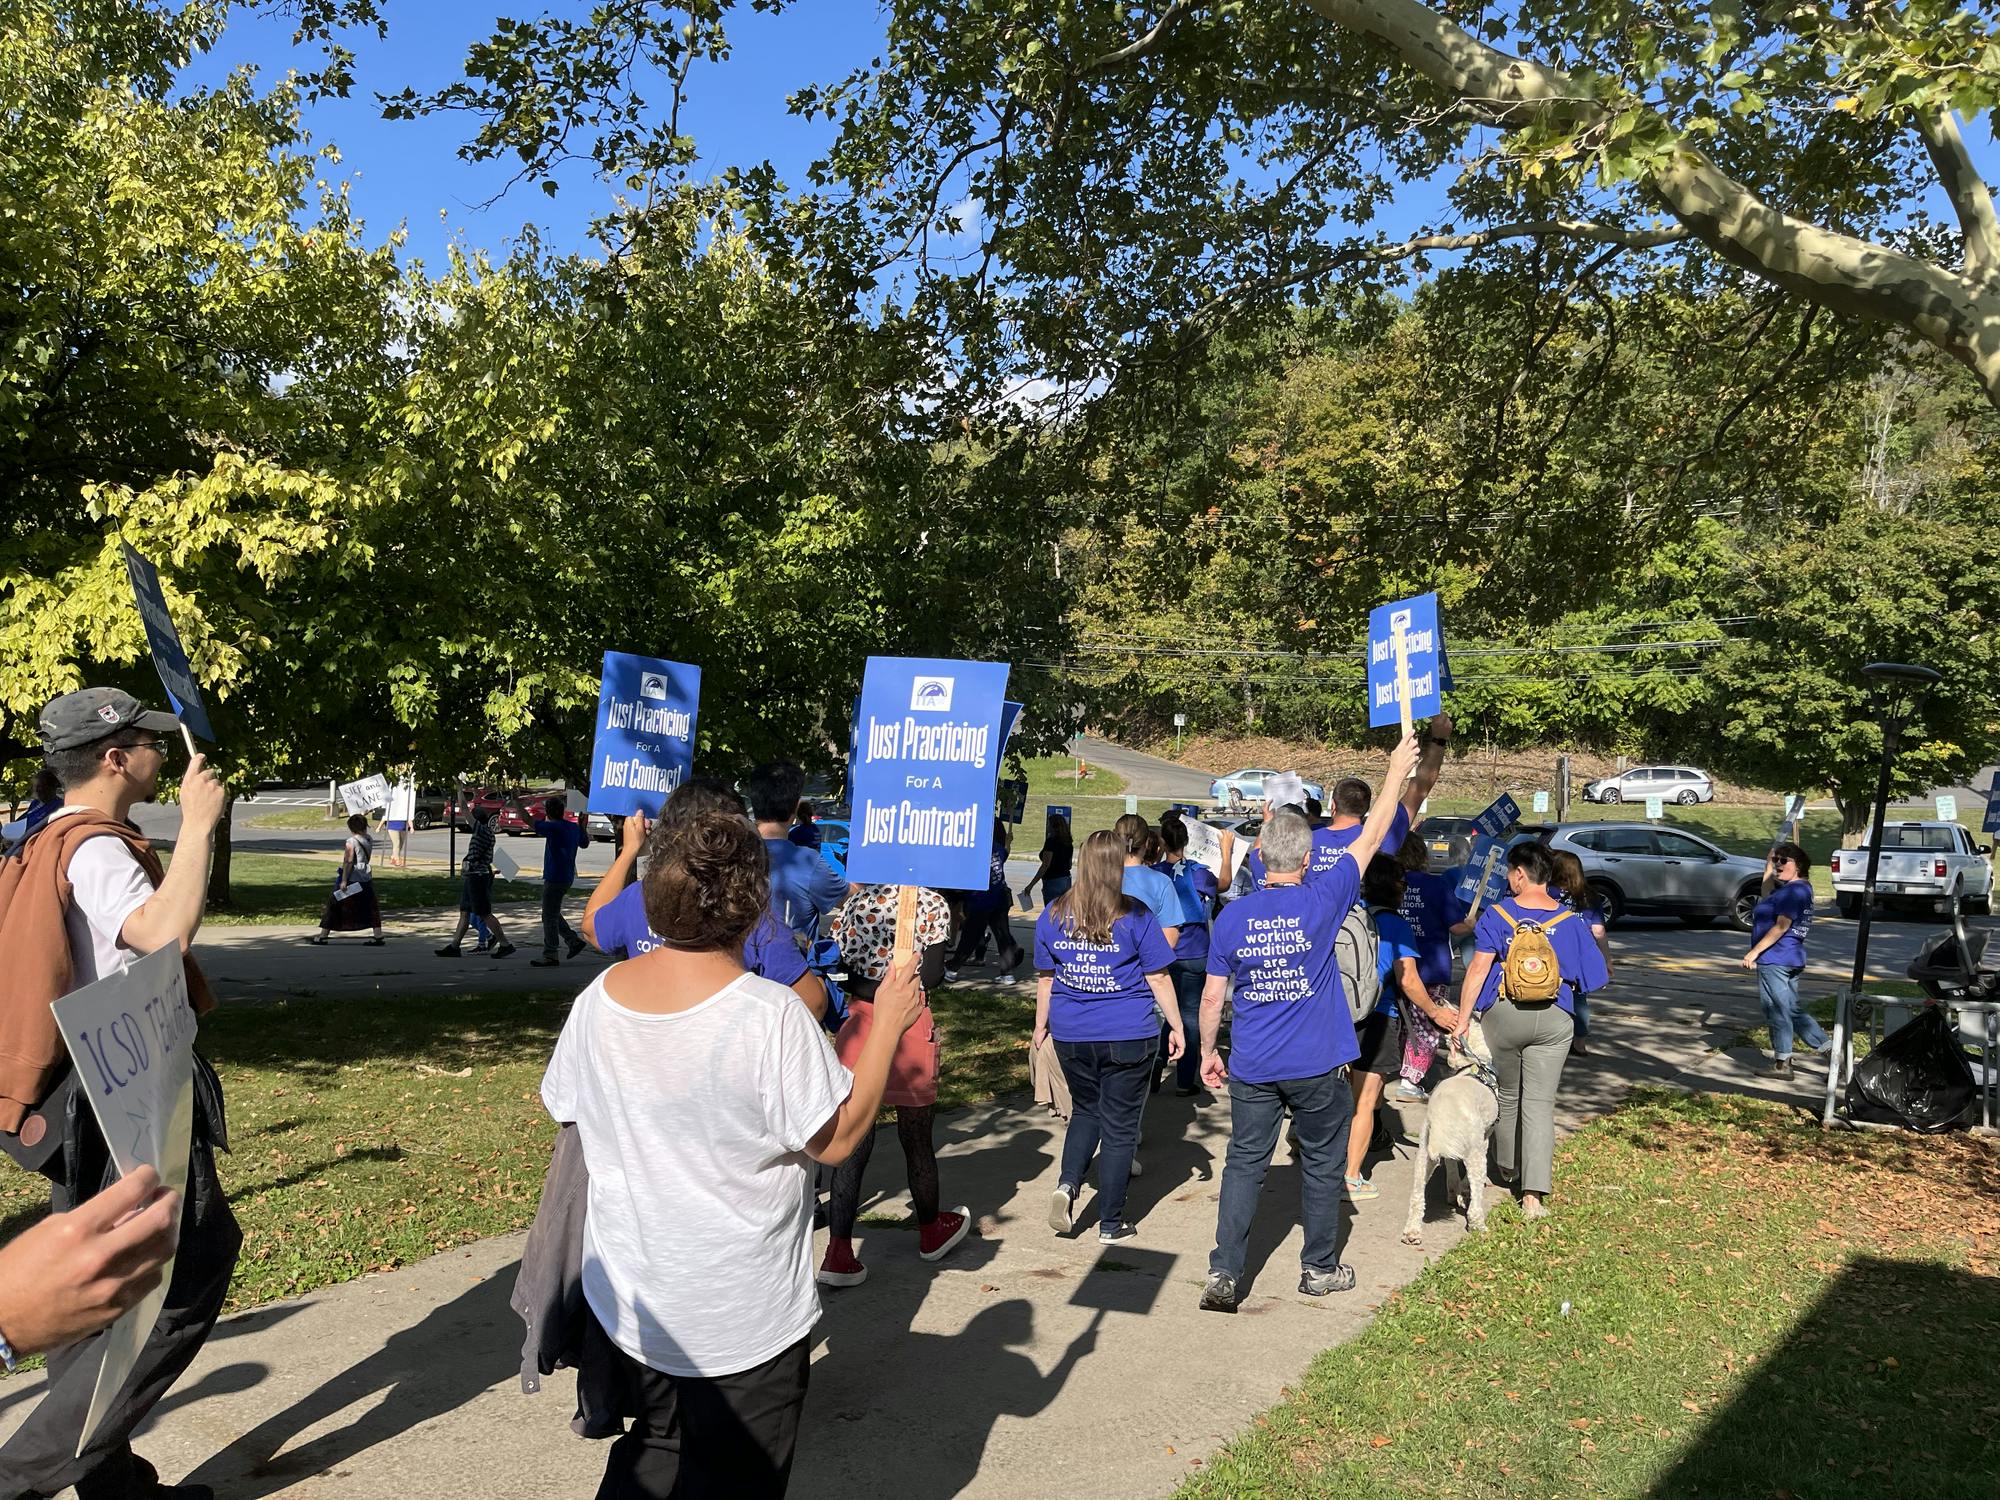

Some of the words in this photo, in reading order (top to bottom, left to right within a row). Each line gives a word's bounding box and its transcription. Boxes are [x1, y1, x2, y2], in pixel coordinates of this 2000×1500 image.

[1372, 639, 1389, 665] Just
[1390, 629, 1432, 659] Pticing
[1375, 682, 1393, 708] Just
[1393, 671, 1433, 702] Ctract!
[606, 696, 634, 730] Just
[634, 700, 691, 742] Practicing
[636, 741, 651, 751] For
[654, 744, 661, 753] A
[866, 716, 901, 763] Just
[901, 717, 989, 768] Practicing
[601, 754, 629, 789] Just
[366, 779, 382, 791] and
[905, 776, 929, 788] For
[932, 777, 942, 789] A
[861, 799, 897, 847] Just
[897, 800, 978, 848] Contract!
[1247, 915, 1300, 931] Teacher
[1246, 929, 1306, 944] working
[1053, 939, 1121, 953] conditions
[1236, 941, 1312, 958] conditions
[1075, 953, 1097, 963] are
[1263, 958, 1287, 968] are
[1250, 965, 1305, 979] student
[1252, 978, 1309, 991] learning
[80, 1012, 149, 1096] ICSD
